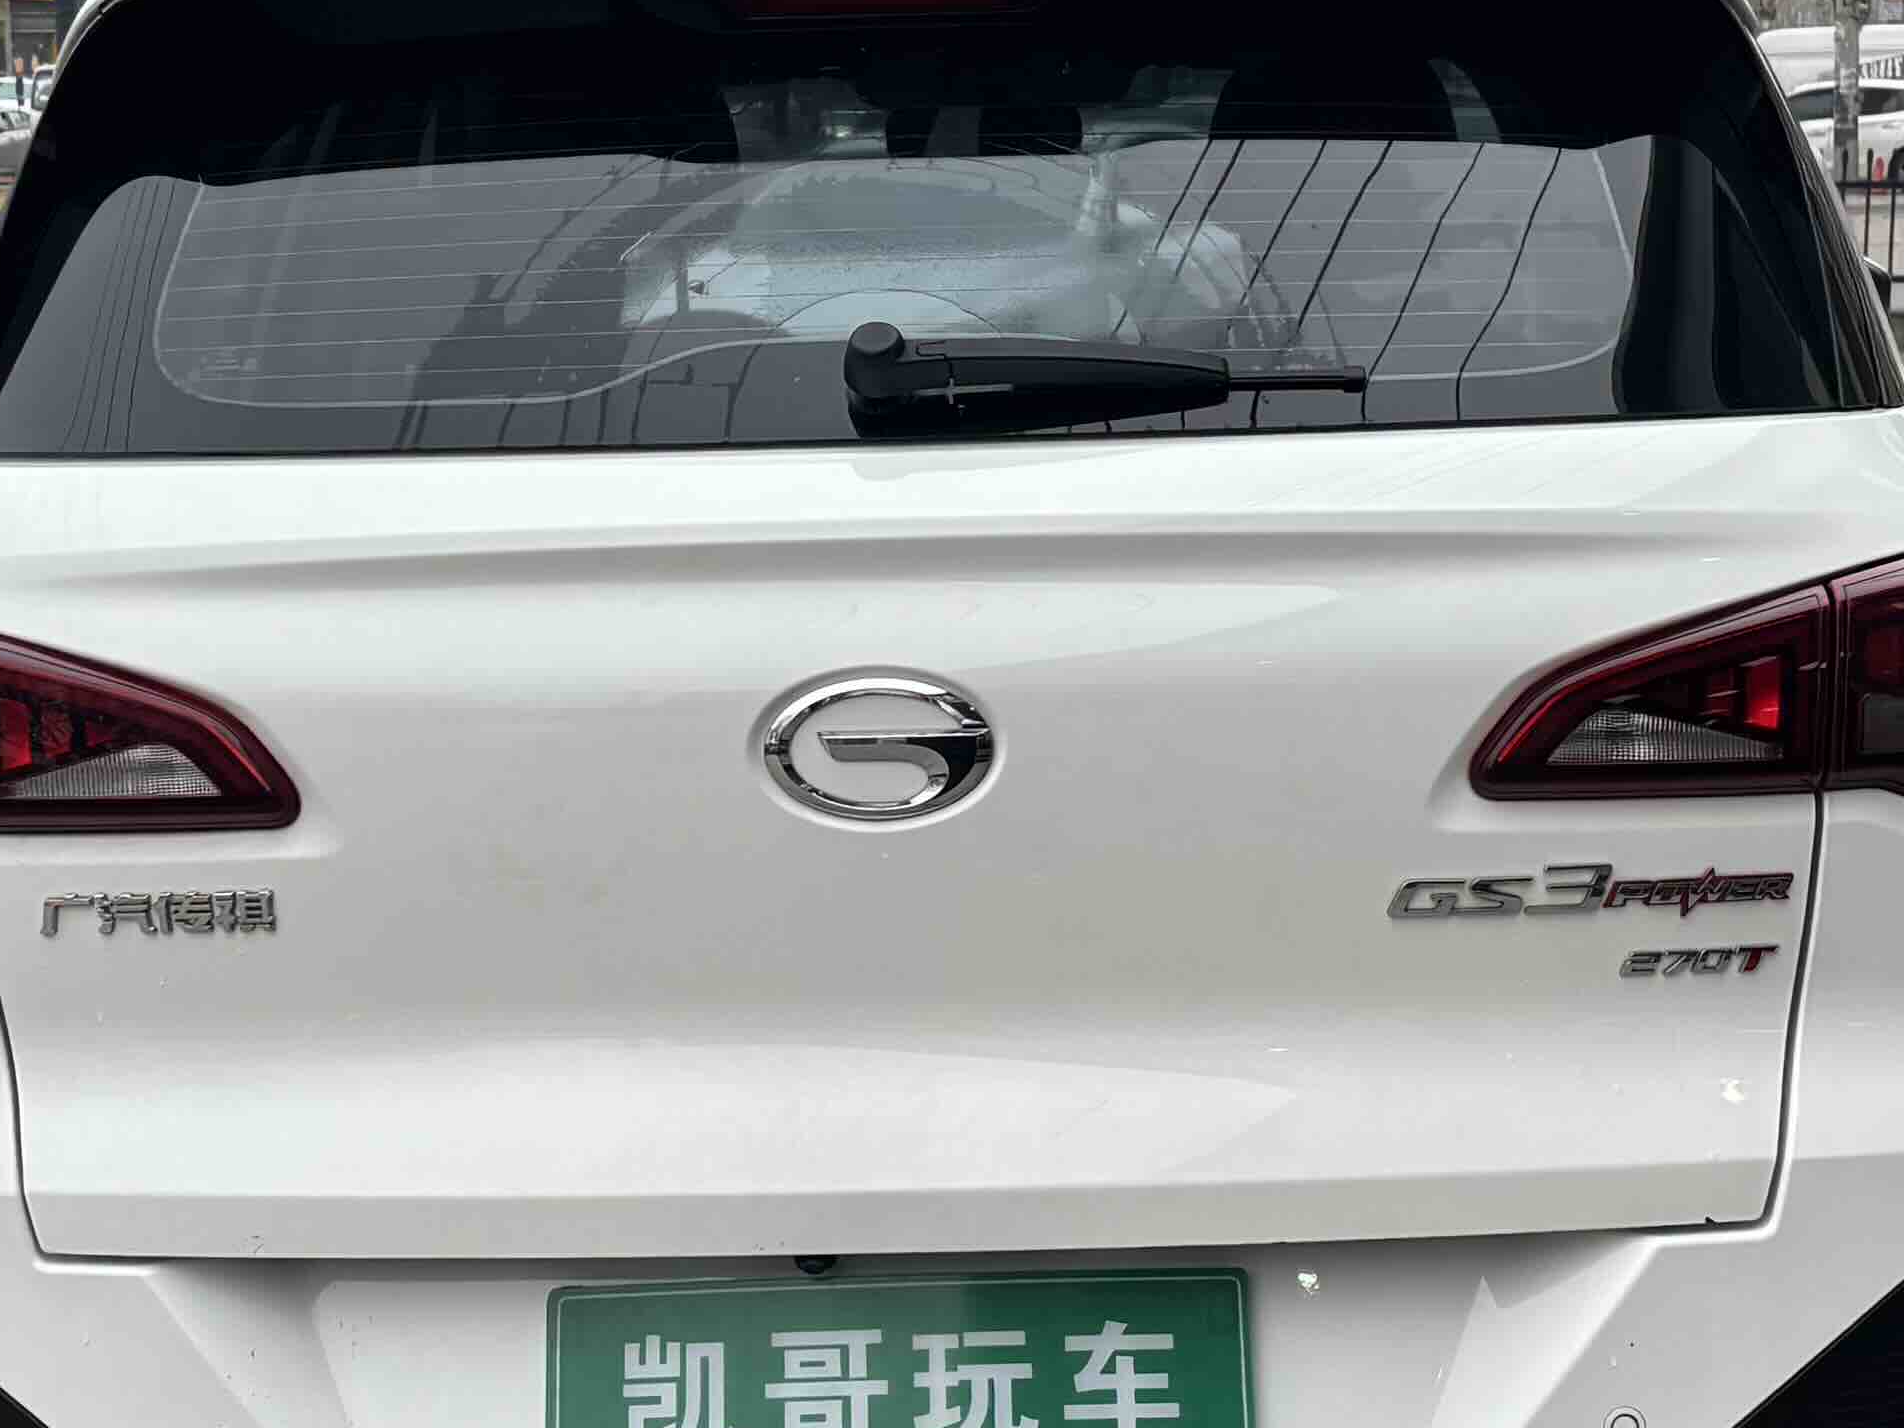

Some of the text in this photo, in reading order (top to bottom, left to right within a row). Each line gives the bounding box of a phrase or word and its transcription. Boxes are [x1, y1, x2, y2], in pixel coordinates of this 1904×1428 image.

[40, 887, 277, 937] 广汽传祺
[1387, 862, 1794, 918] GS3 POWER
[1619, 944, 1780, 979] 270T
